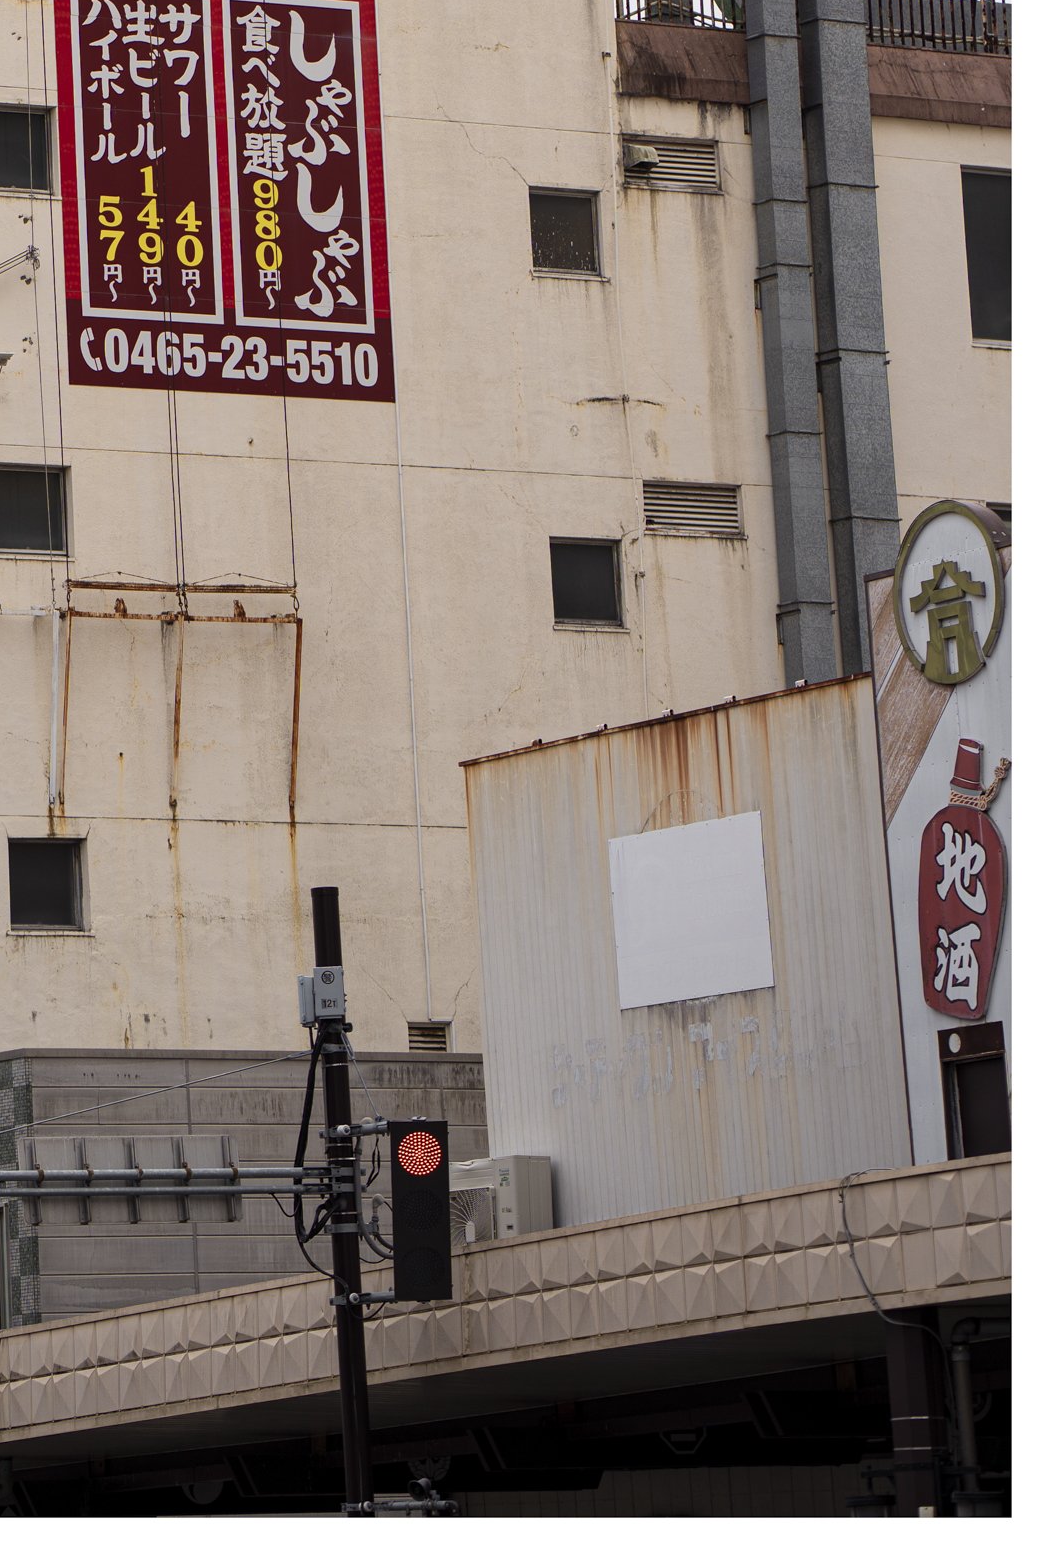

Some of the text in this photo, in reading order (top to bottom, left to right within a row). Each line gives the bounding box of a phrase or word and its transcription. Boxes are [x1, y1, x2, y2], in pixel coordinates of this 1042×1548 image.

[122, 0, 166, 159] 生ビール
[159, 3, 202, 138] サワー
[236, 4, 289, 181] 食べ放題
[288, 9, 361, 318] しゃぶしゃぶ
[104, 327, 380, 388] 0465-23-5510
[935, 822, 987, 1011] 地酒
